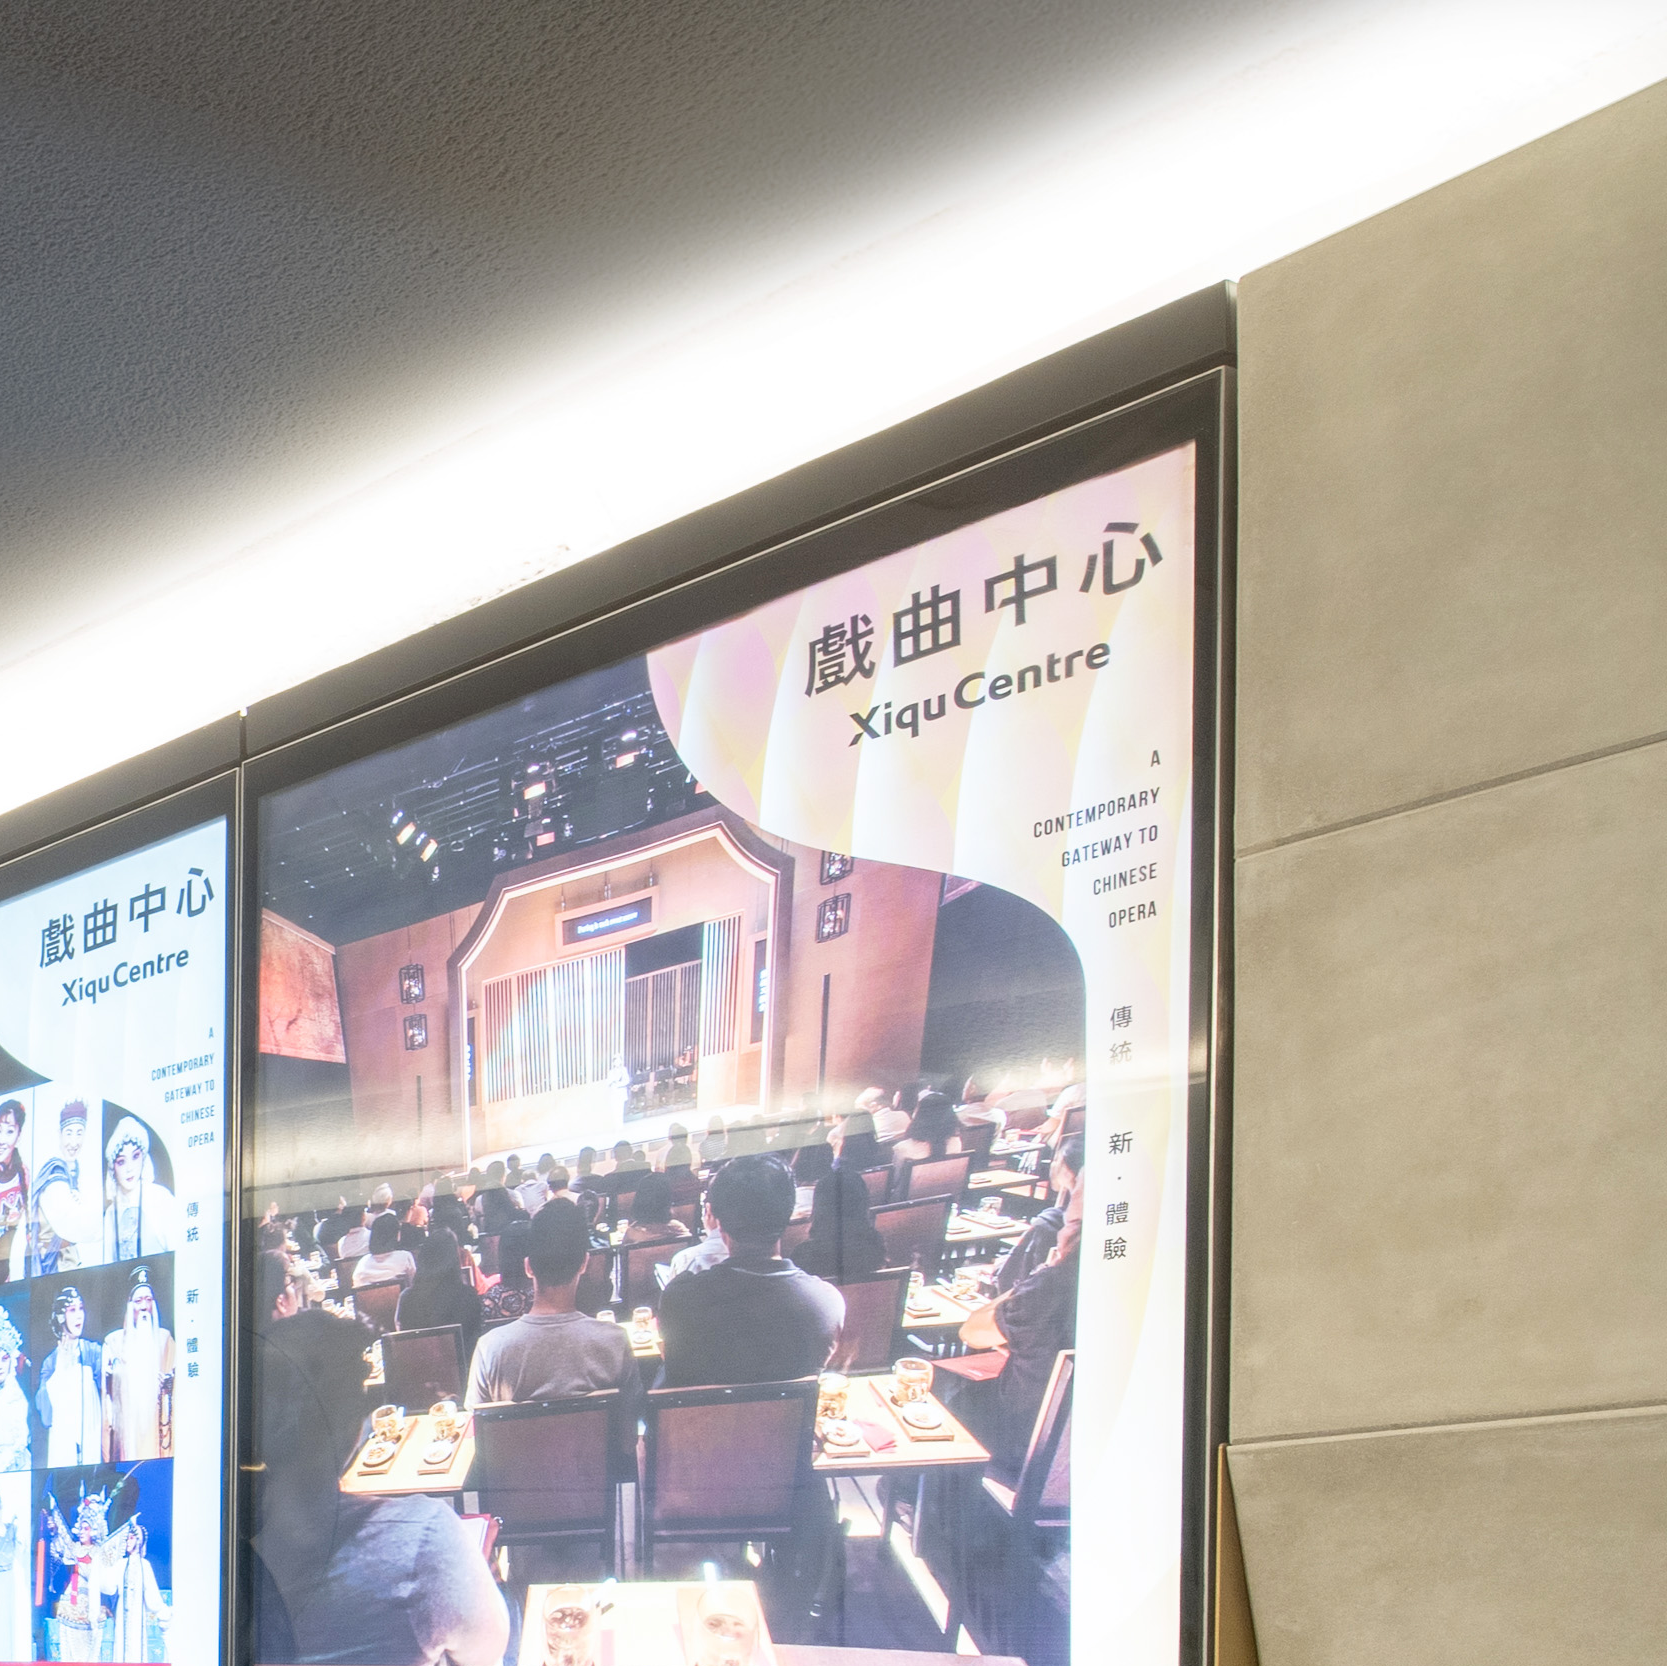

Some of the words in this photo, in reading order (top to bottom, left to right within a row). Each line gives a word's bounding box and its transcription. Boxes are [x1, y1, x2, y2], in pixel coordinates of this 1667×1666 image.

[805, 522, 1163, 697] 戲曲中心
[849, 694, 946, 747] Xiqu
[954, 643, 1110, 709] Centre
[1151, 750, 1160, 767] A
[1034, 787, 1160, 838] CONTEMPORARY
[1062, 832, 1132, 867] GATEWAY
[1139, 825, 1158, 844] TO
[1094, 862, 1157, 895] CHINESE
[39, 867, 214, 968] 戲曲中心
[1107, 899, 1158, 930] OPERA
[62, 975, 109, 1006] Xiqu
[113, 950, 189, 987] Centre
[208, 1026, 214, 1039] A
[1109, 1003, 1133, 1065] 傳統
[152, 1054, 213, 1080] CONTEMPORARY
[165, 1084, 201, 1102] GATEWAY
[205, 1079, 214, 1091] TO
[181, 1105, 214, 1124] CHINESE
[188, 1132, 214, 1147] OPERA
